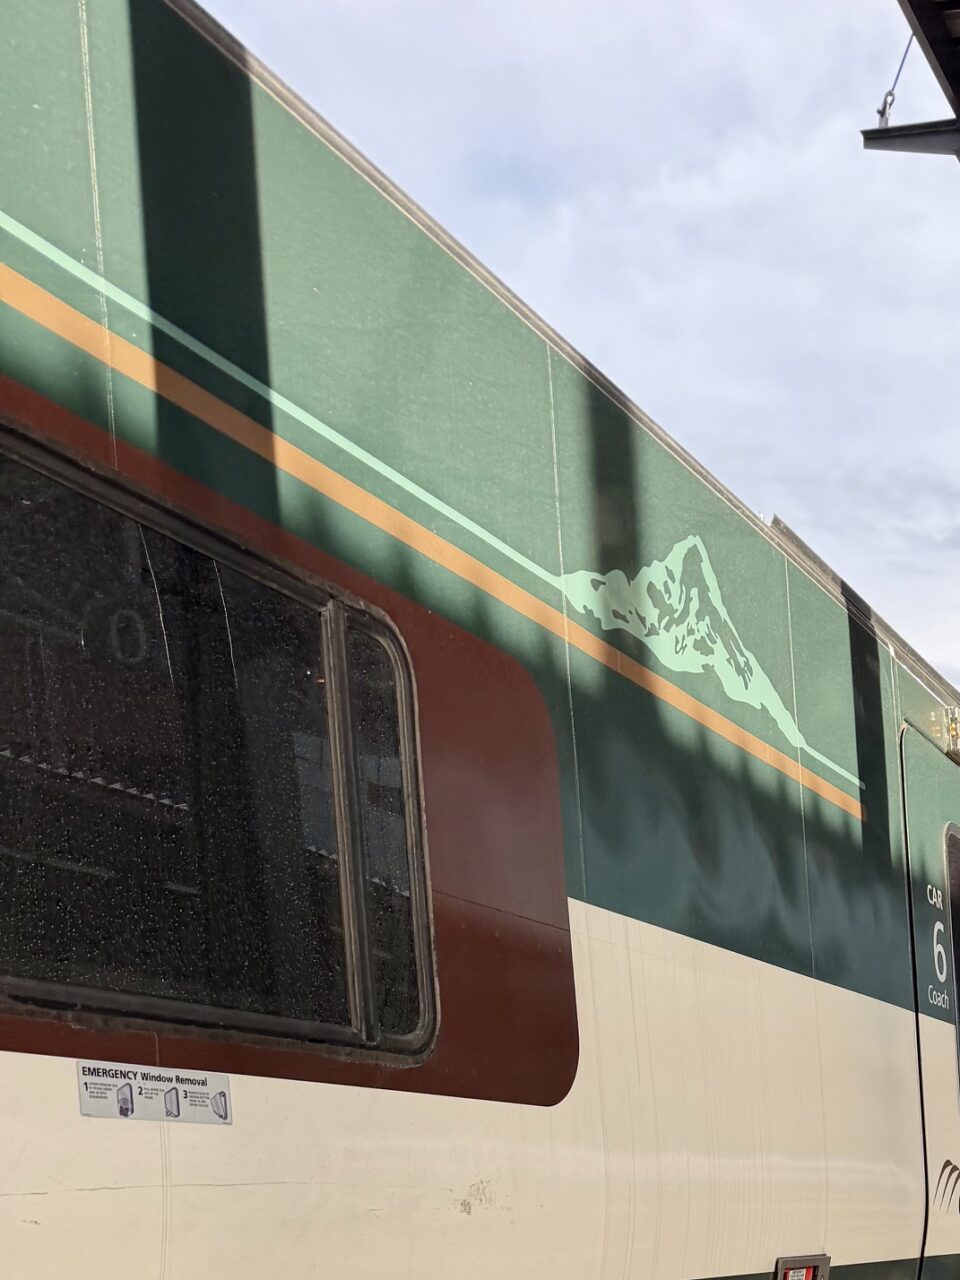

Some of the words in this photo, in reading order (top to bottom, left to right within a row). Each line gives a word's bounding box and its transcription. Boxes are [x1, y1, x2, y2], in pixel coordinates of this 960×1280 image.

[926, 884, 943, 911] CAR
[933, 920, 948, 983] 6
[928, 985, 949, 1009] Coach
[81, 1066, 138, 1081] EMERGENCY
[140, 1071, 174, 1083] Window
[175, 1074, 208, 1087] Removal
[83, 1081, 89, 1091] 1
[138, 1086, 143, 1096] 2
[182, 1090, 188, 1099] 3
